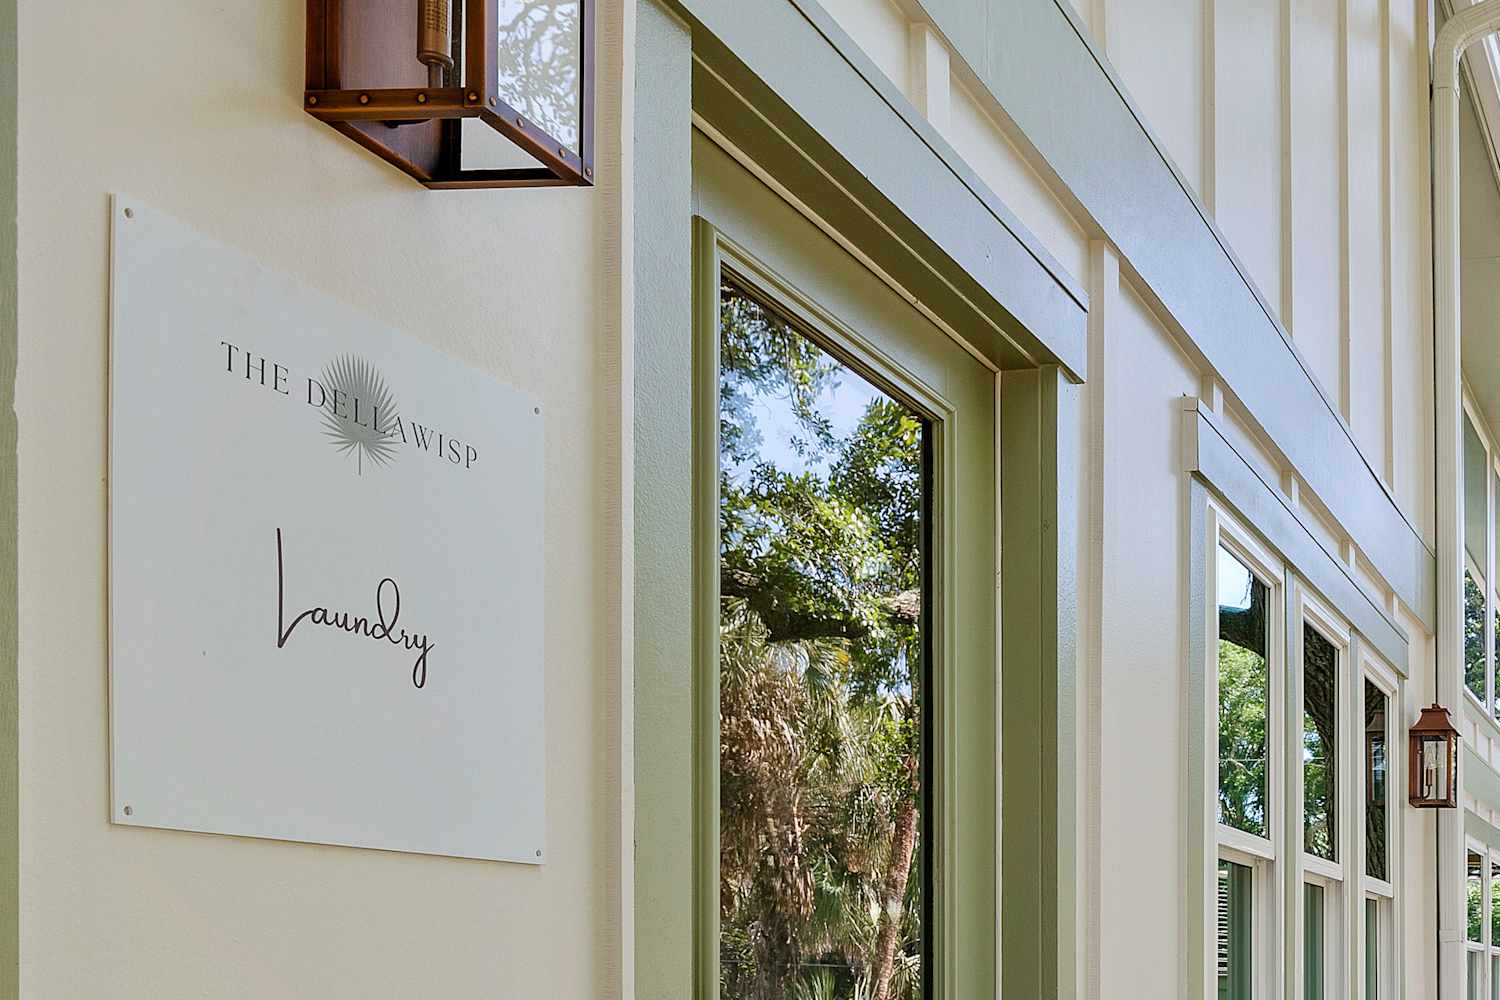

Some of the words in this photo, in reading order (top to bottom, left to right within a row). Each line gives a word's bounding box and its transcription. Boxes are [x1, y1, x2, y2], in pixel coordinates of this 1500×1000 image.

[221, 341, 289, 395] THE
[307, 377, 478, 468] DELLAWISP
[276, 527, 436, 689] Laundry
